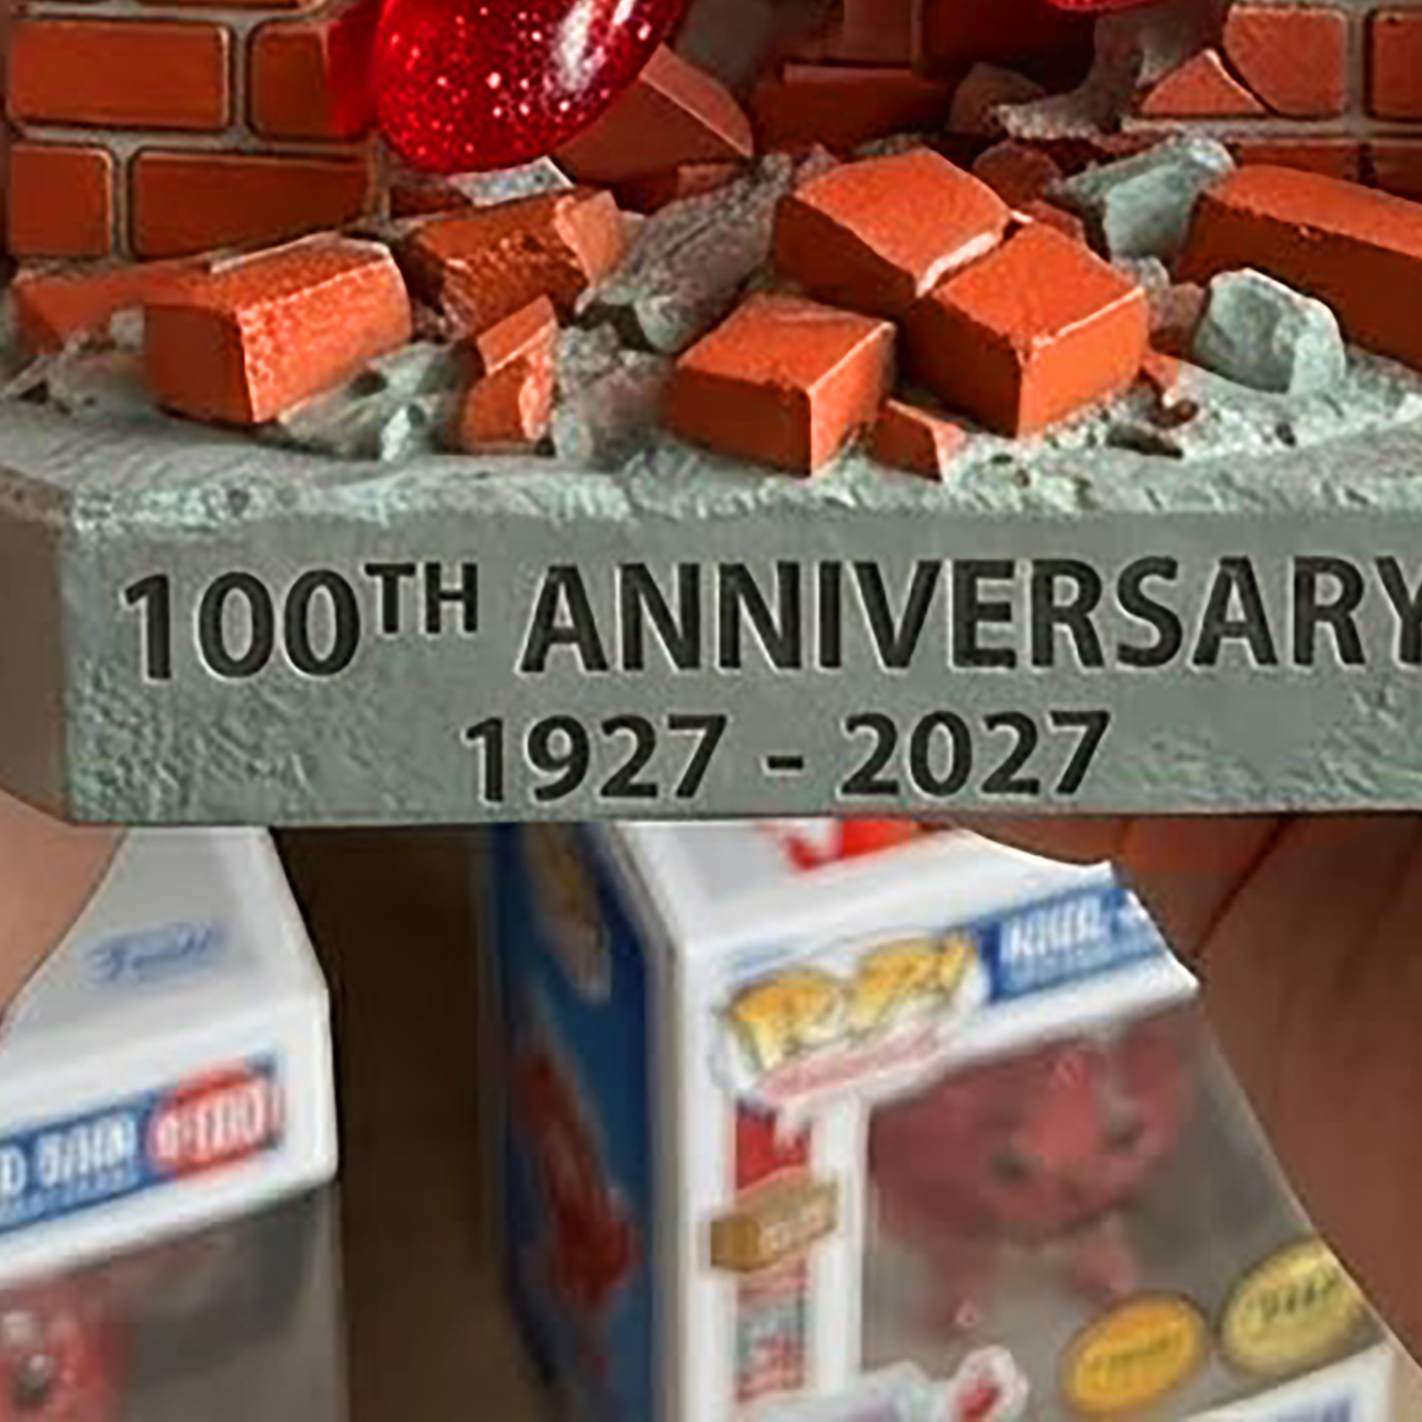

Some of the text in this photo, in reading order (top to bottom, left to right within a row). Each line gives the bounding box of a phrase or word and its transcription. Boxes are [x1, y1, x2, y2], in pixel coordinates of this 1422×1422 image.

[123, 561, 478, 681] 100TH
[463, 713, 729, 803] 1927
[840, 709, 1112, 798] 2027
